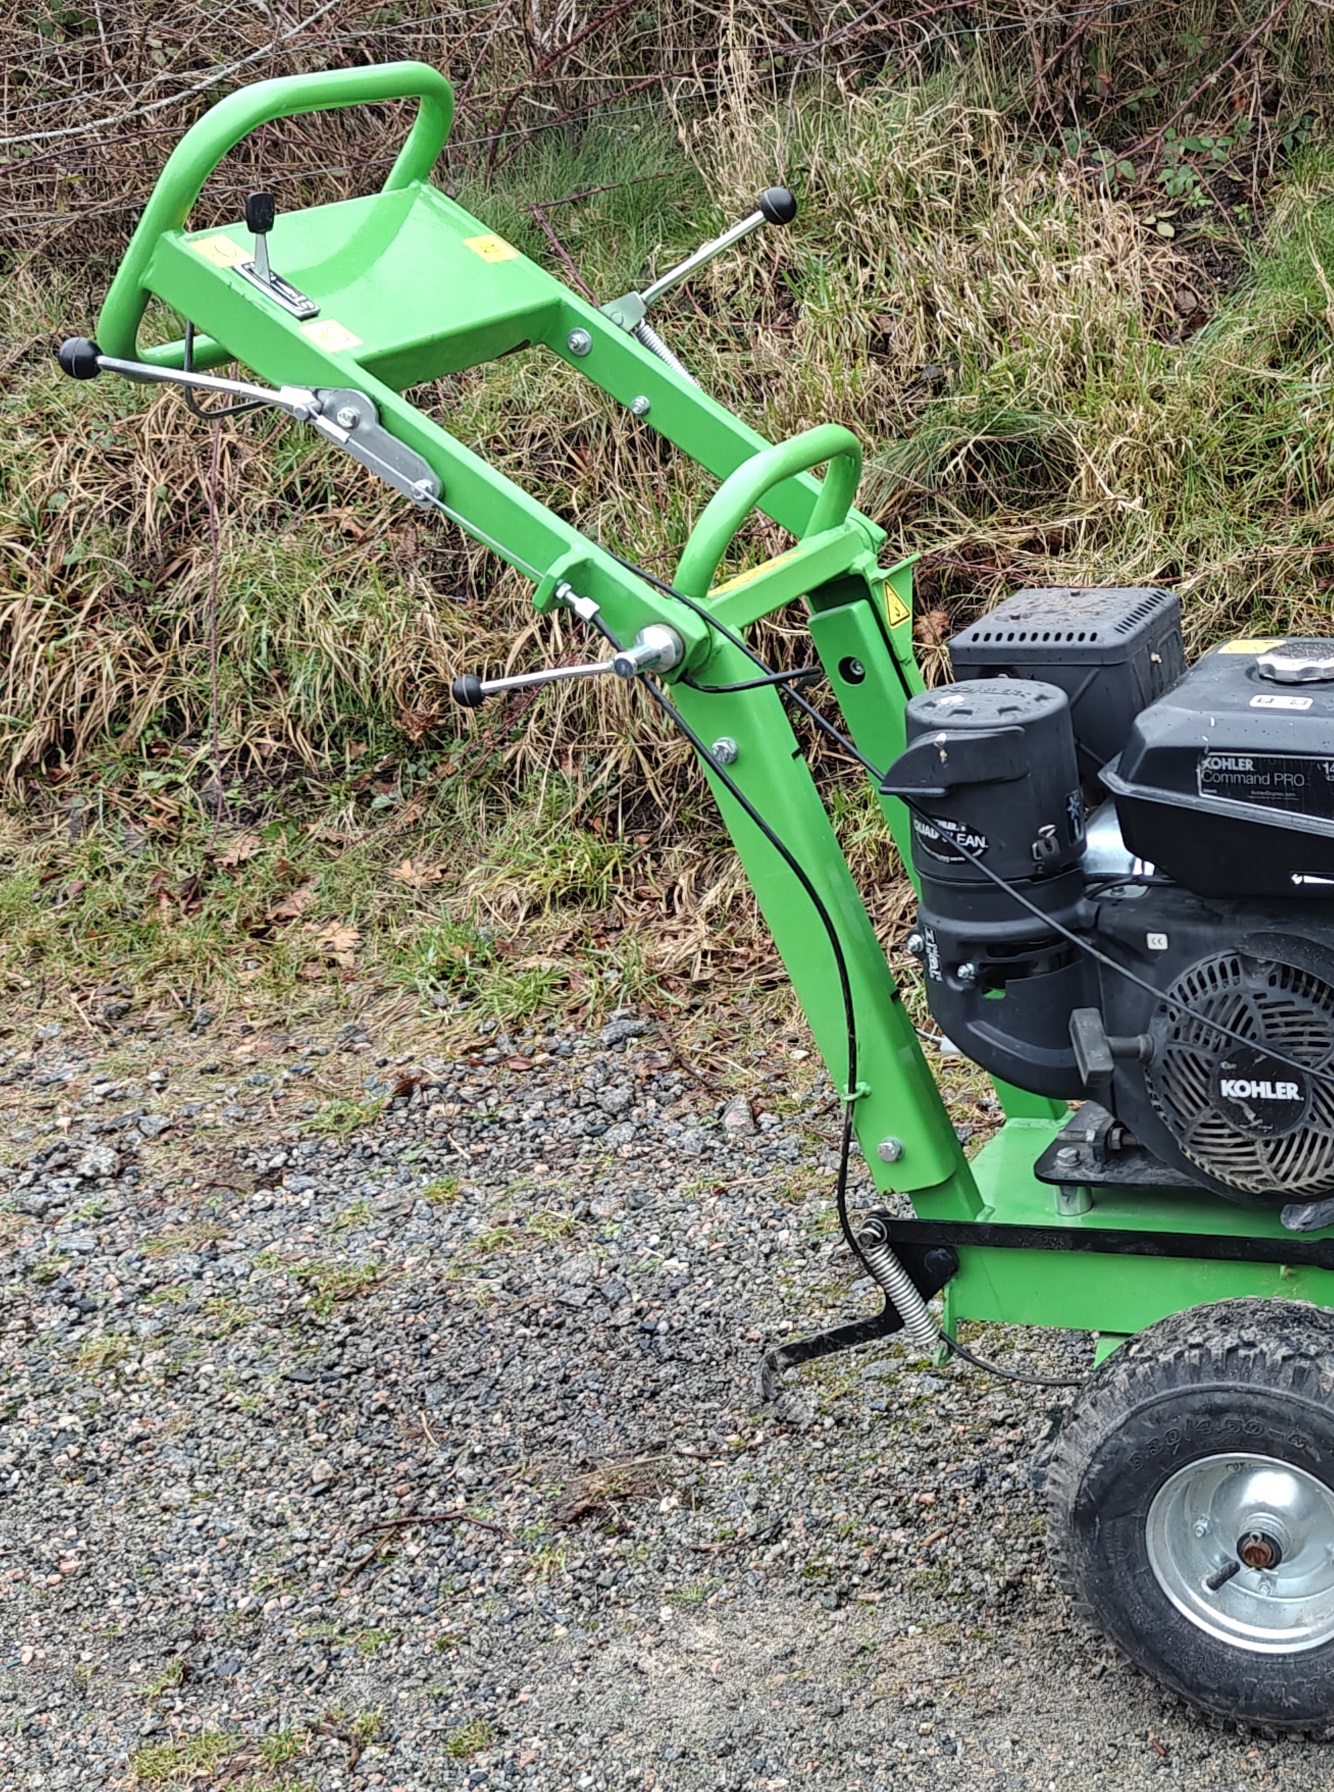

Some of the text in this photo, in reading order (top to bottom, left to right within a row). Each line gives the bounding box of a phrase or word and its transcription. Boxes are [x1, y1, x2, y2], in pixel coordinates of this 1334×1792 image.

[1202, 757, 1255, 772] KOHLER
[1202, 769, 1305, 787] Command PRO
